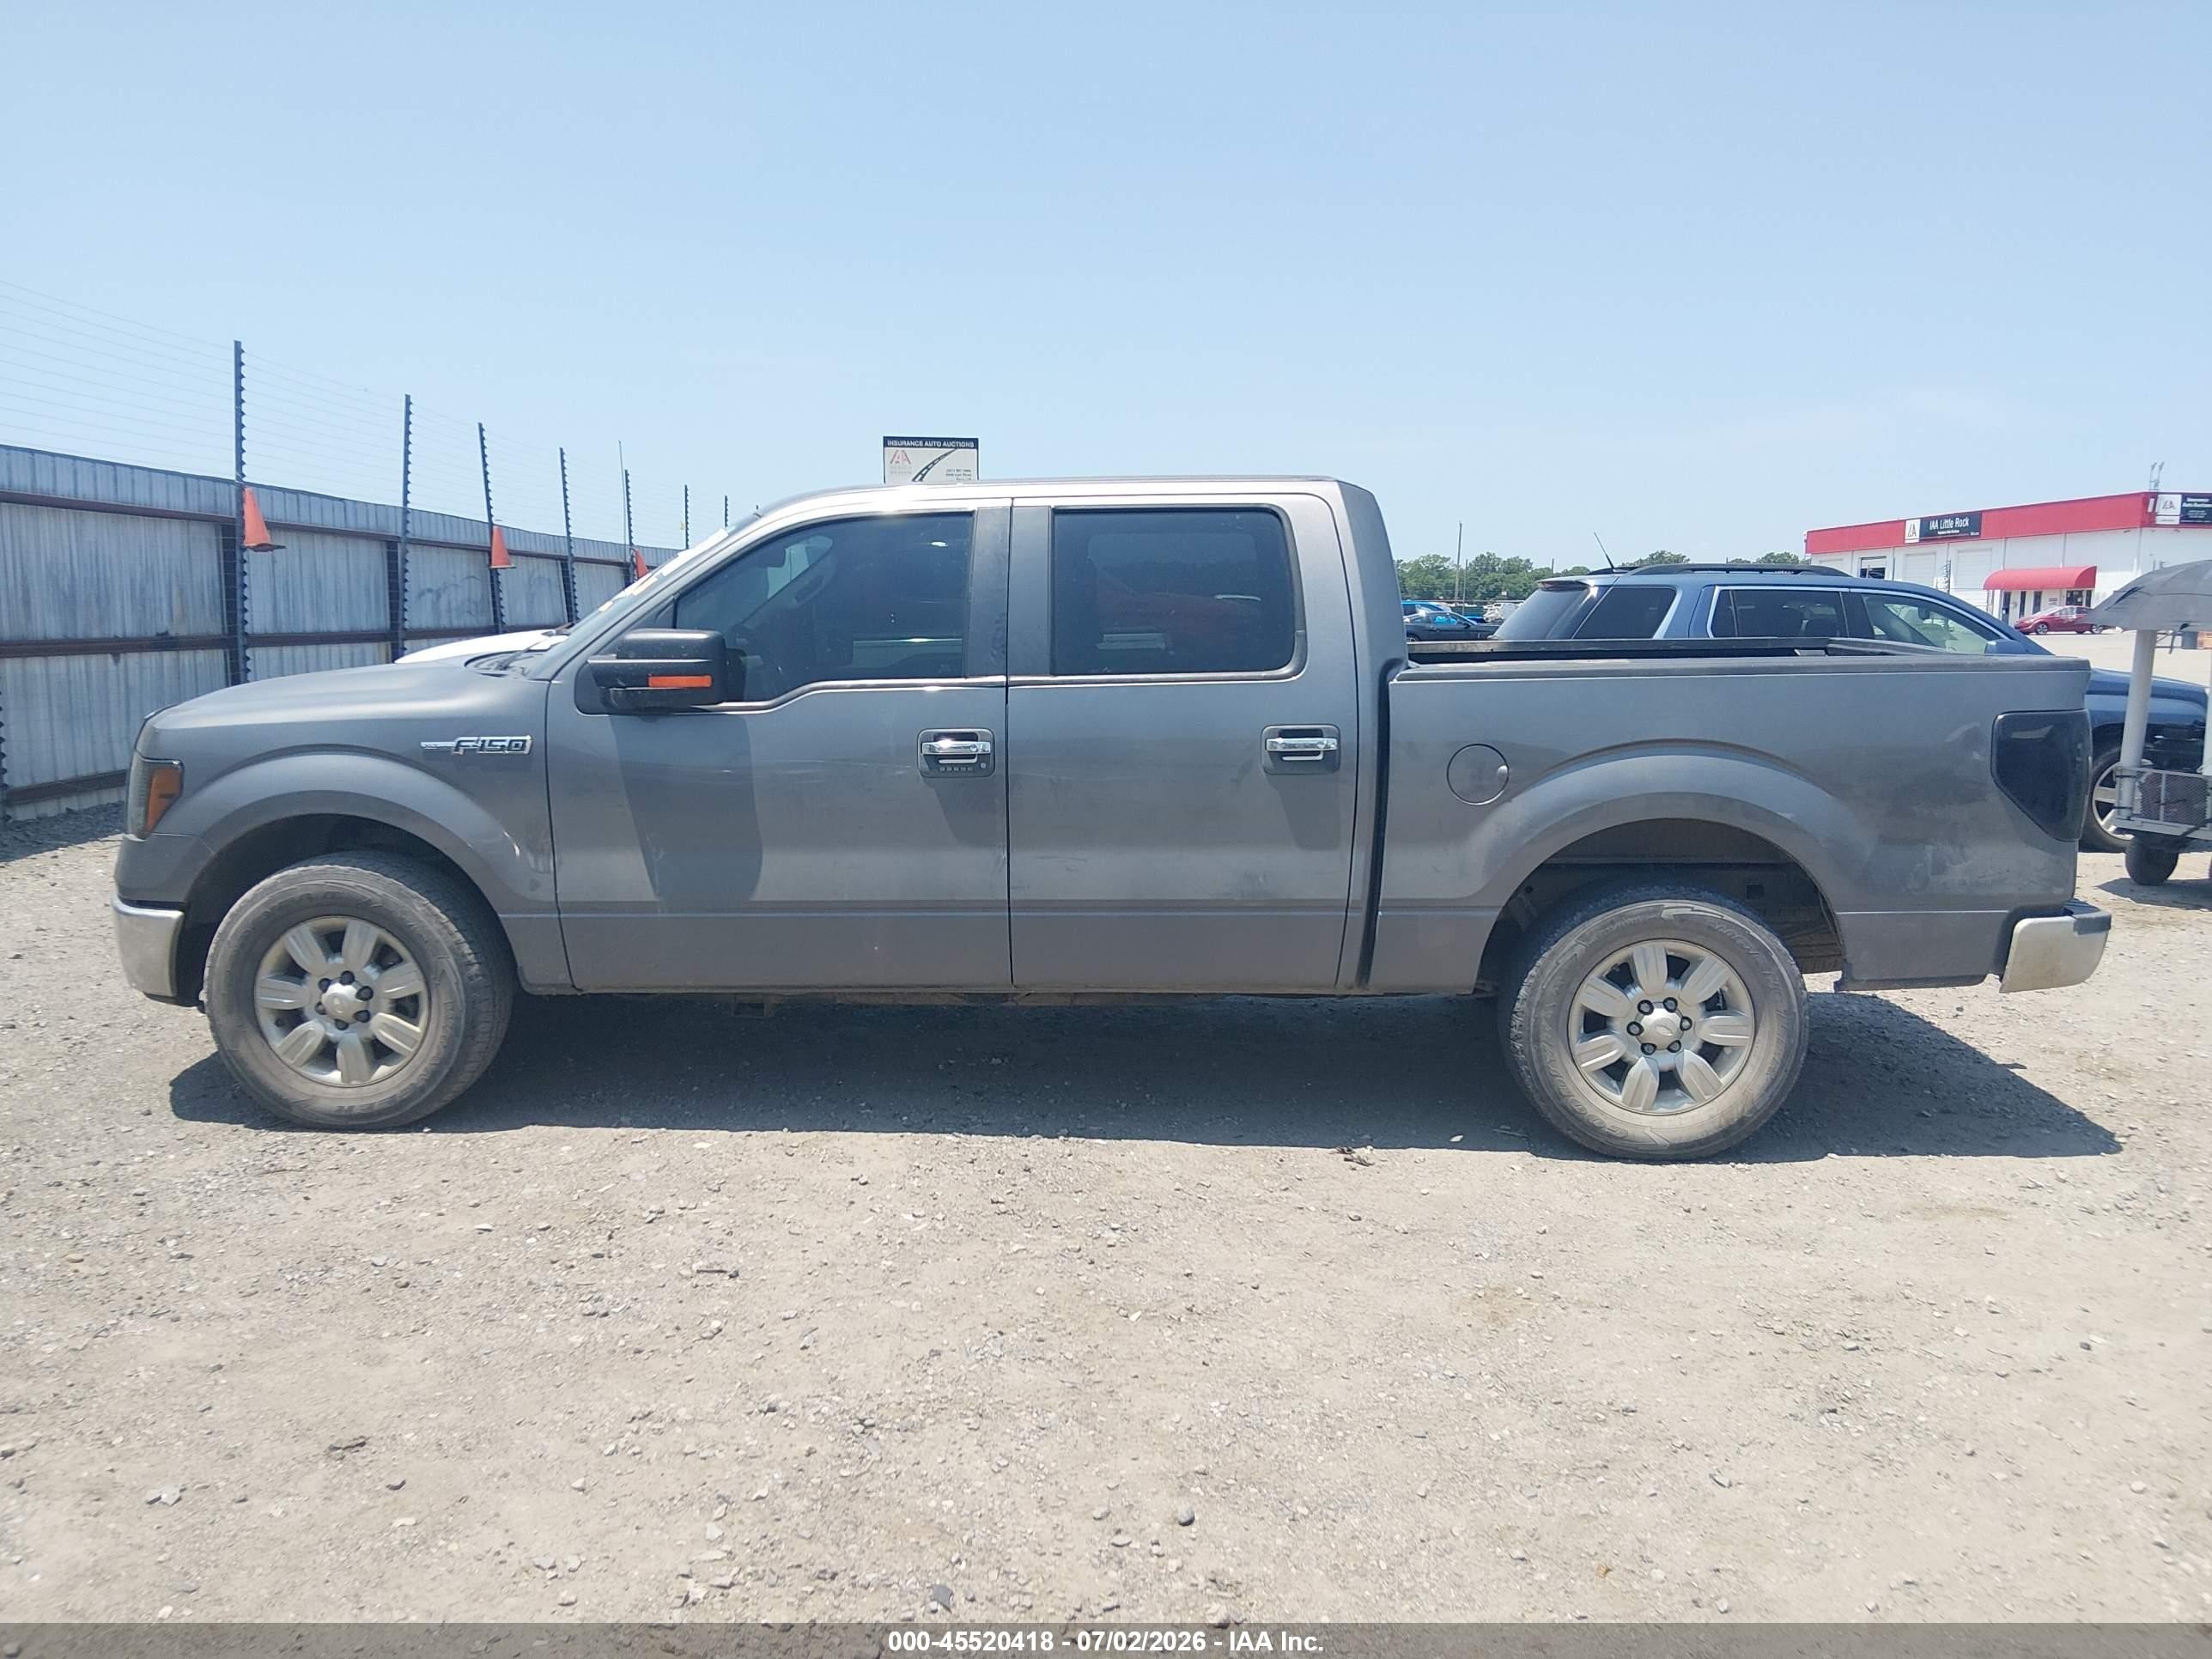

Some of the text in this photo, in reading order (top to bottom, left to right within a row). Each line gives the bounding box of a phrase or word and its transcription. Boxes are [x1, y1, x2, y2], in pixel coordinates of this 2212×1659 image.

[887, 439, 923, 447] INSURANCE
[1940, 518, 1954, 530] Little
[1954, 516, 1970, 528] Rock
